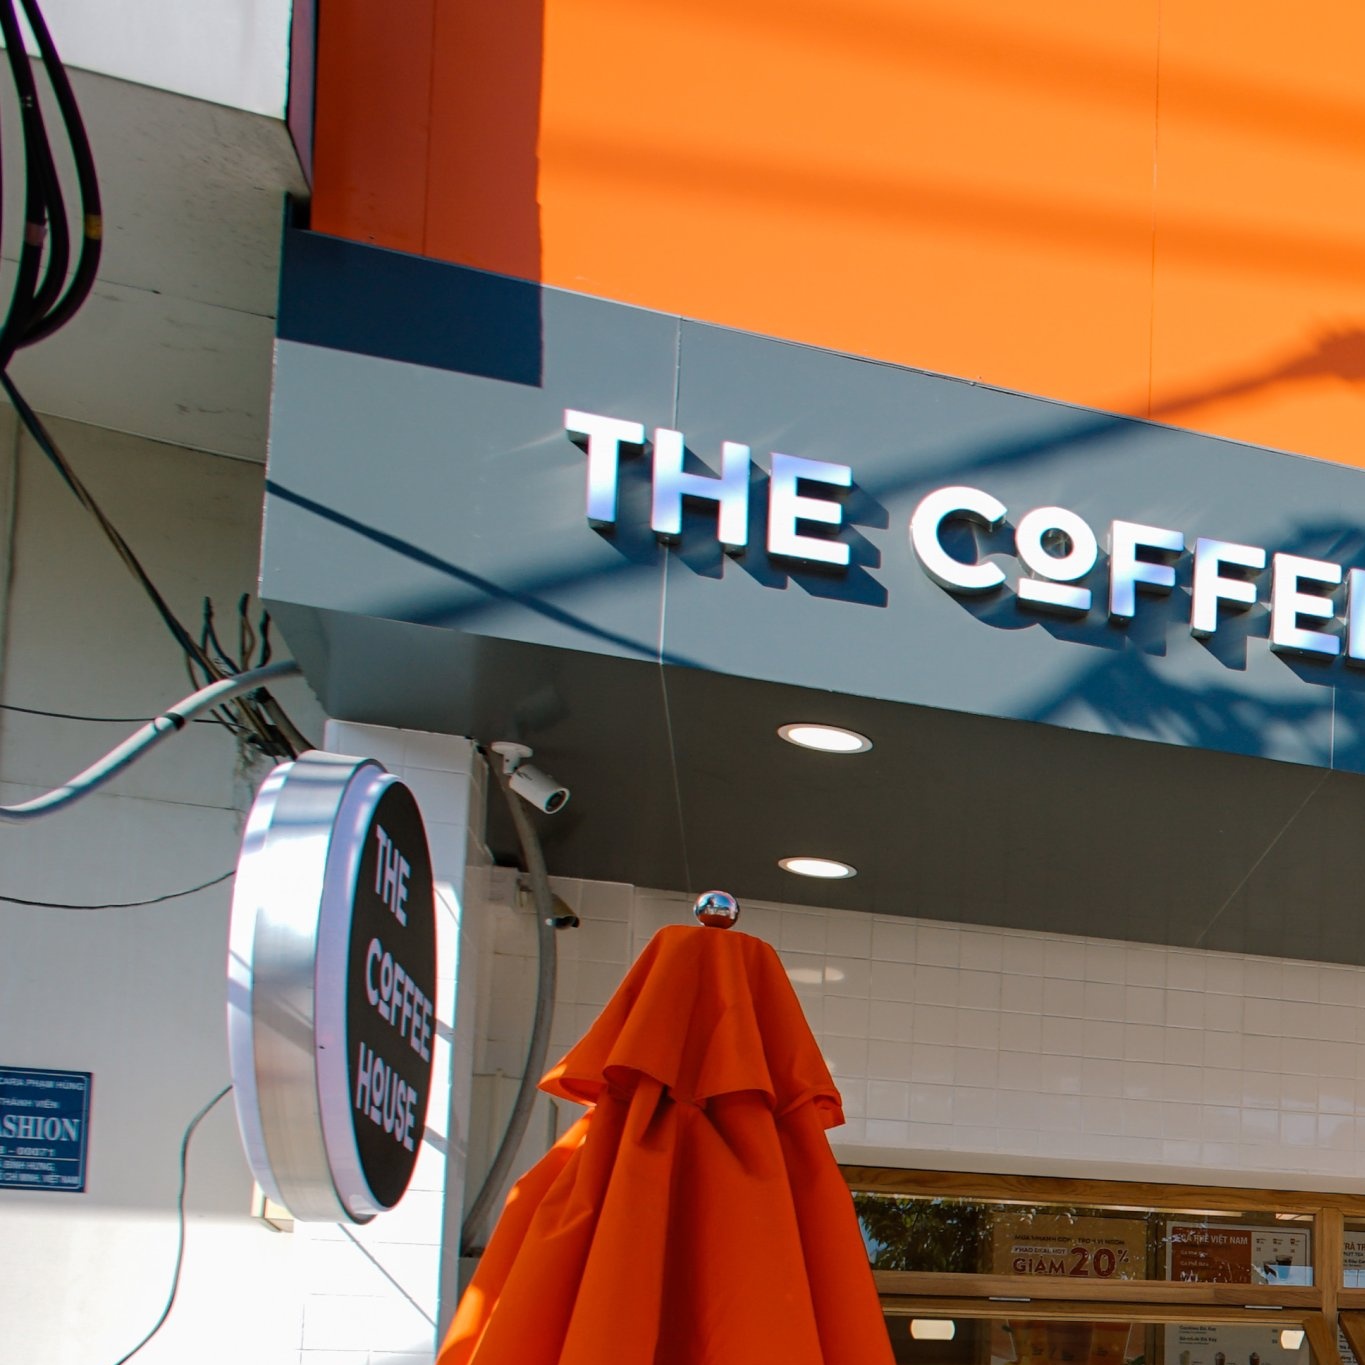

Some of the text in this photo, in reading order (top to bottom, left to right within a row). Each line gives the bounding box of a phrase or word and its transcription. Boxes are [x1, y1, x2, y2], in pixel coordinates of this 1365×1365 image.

[564, 408, 853, 568] THE
[376, 824, 411, 927] THE
[365, 937, 433, 1064] COFFEE
[356, 1041, 418, 1153] HOUSE
[1068, 1246, 1129, 1277] 20%
